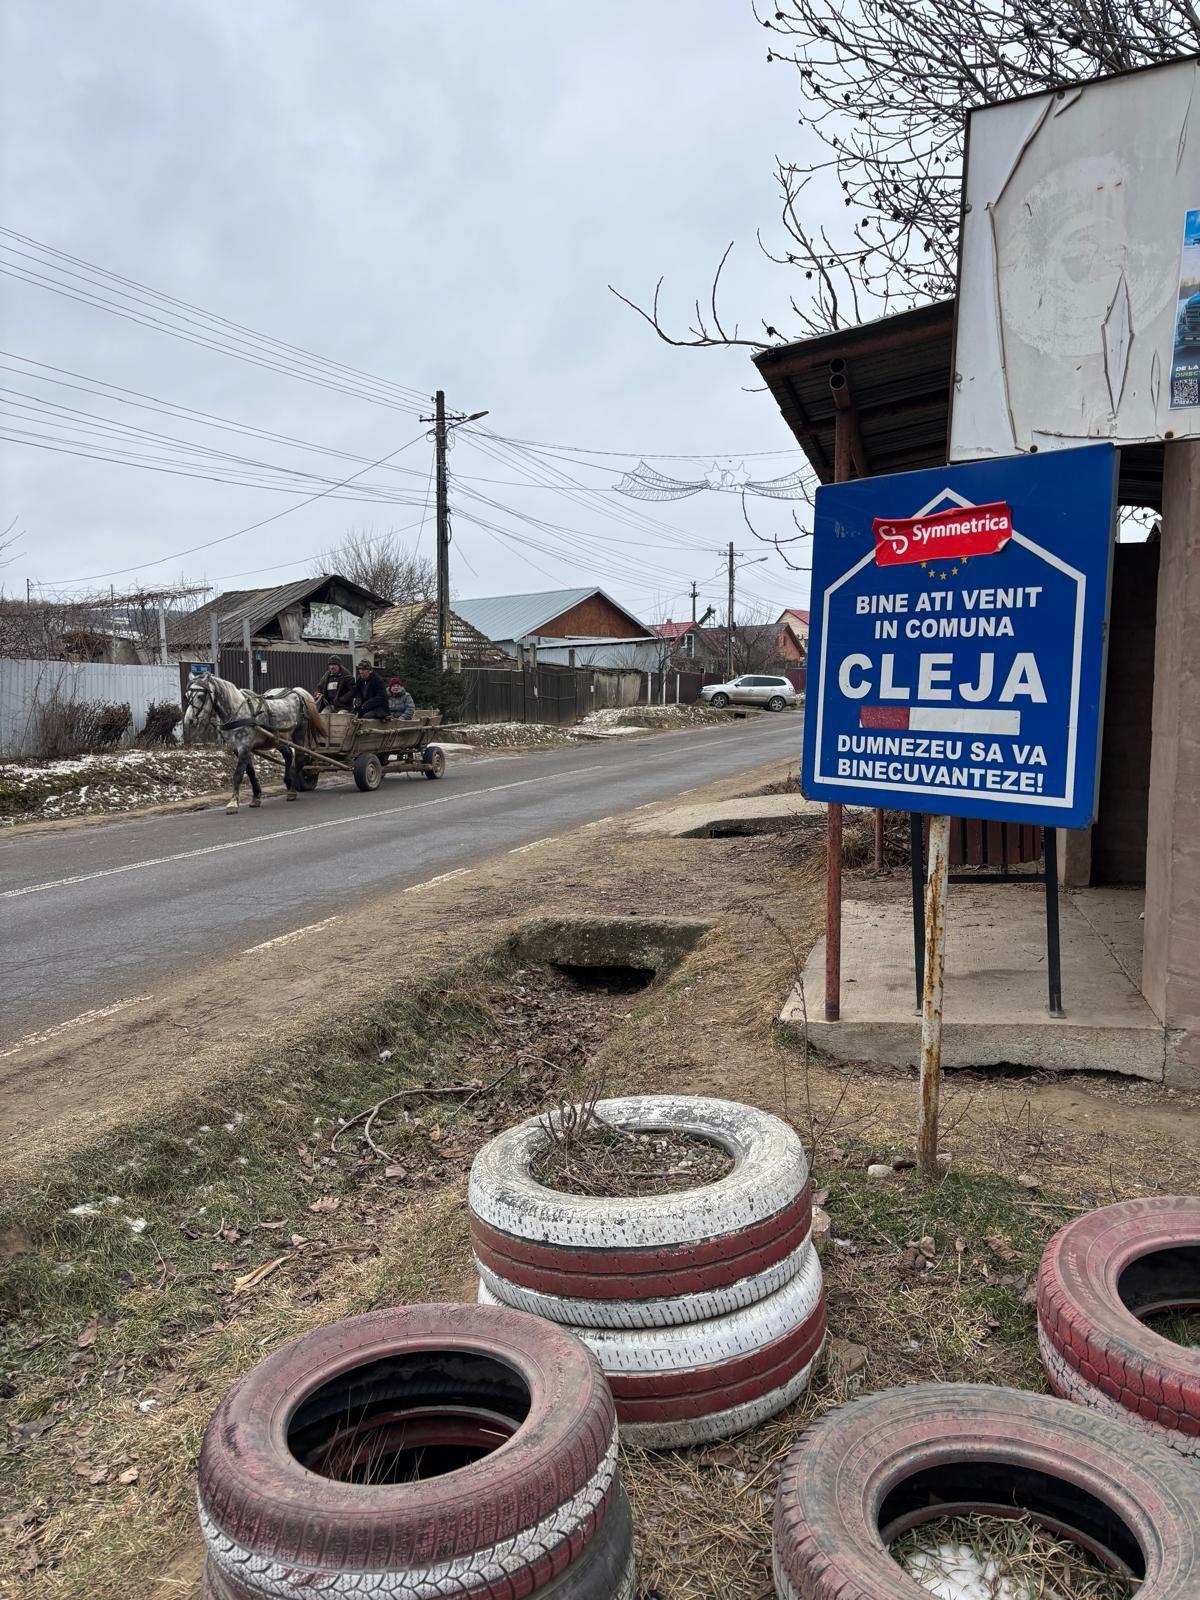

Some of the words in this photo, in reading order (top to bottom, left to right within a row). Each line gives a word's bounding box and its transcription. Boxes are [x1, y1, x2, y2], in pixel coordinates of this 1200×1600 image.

[912, 514, 1008, 544] Symmetrica
[856, 593, 908, 615] BINE
[914, 591, 954, 612] ATI
[961, 586, 1043, 610] VENIT
[874, 620, 898, 640] IN
[905, 616, 1015, 639] COMUNA
[838, 652, 1048, 704] CLEJA
[837, 734, 962, 760] DUMNEZEU
[970, 741, 1004, 763] SA
[1011, 744, 1048, 766] VA
[837, 758, 1044, 793] BINECUVANTEZE!
